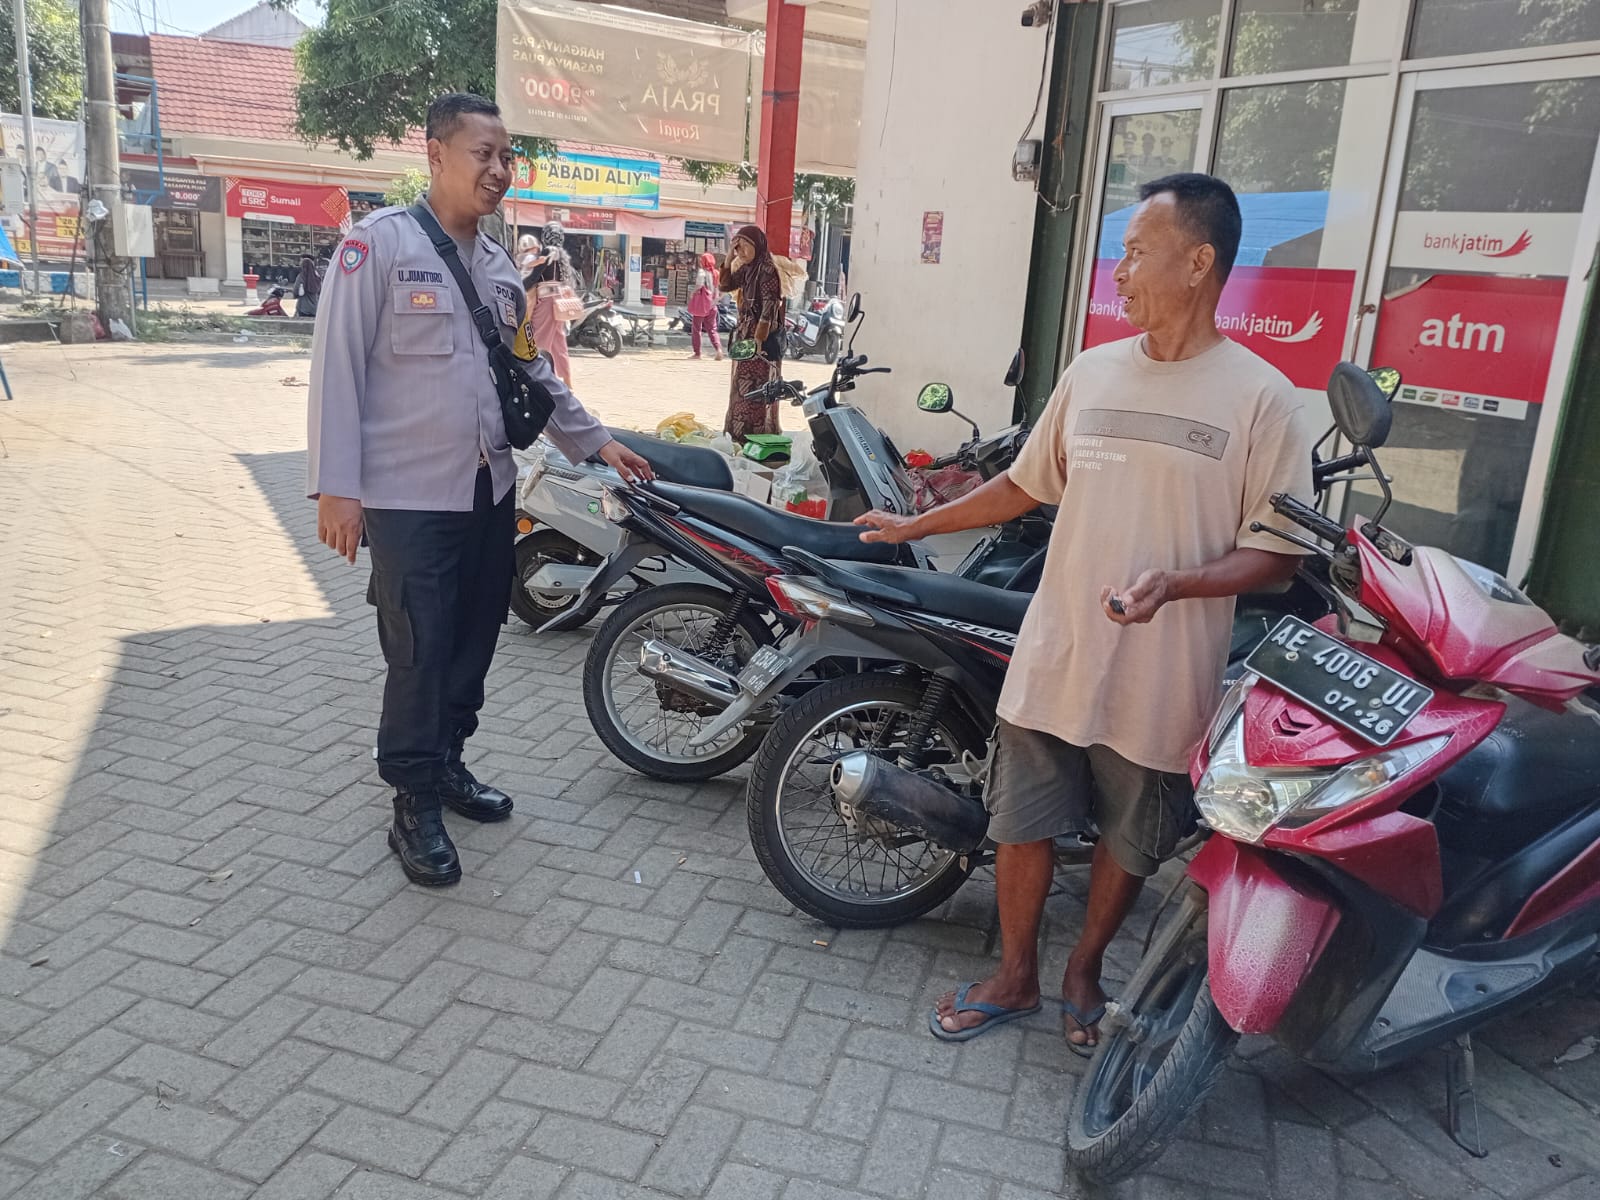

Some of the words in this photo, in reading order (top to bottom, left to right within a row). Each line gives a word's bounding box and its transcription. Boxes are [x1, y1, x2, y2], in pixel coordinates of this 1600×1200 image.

[1424, 233, 1504, 254] bankjatim
[1419, 313, 1505, 353] atm
[1271, 624, 1313, 651] AE
[1312, 645, 1379, 689] 4006
[1382, 681, 1419, 716] UL
